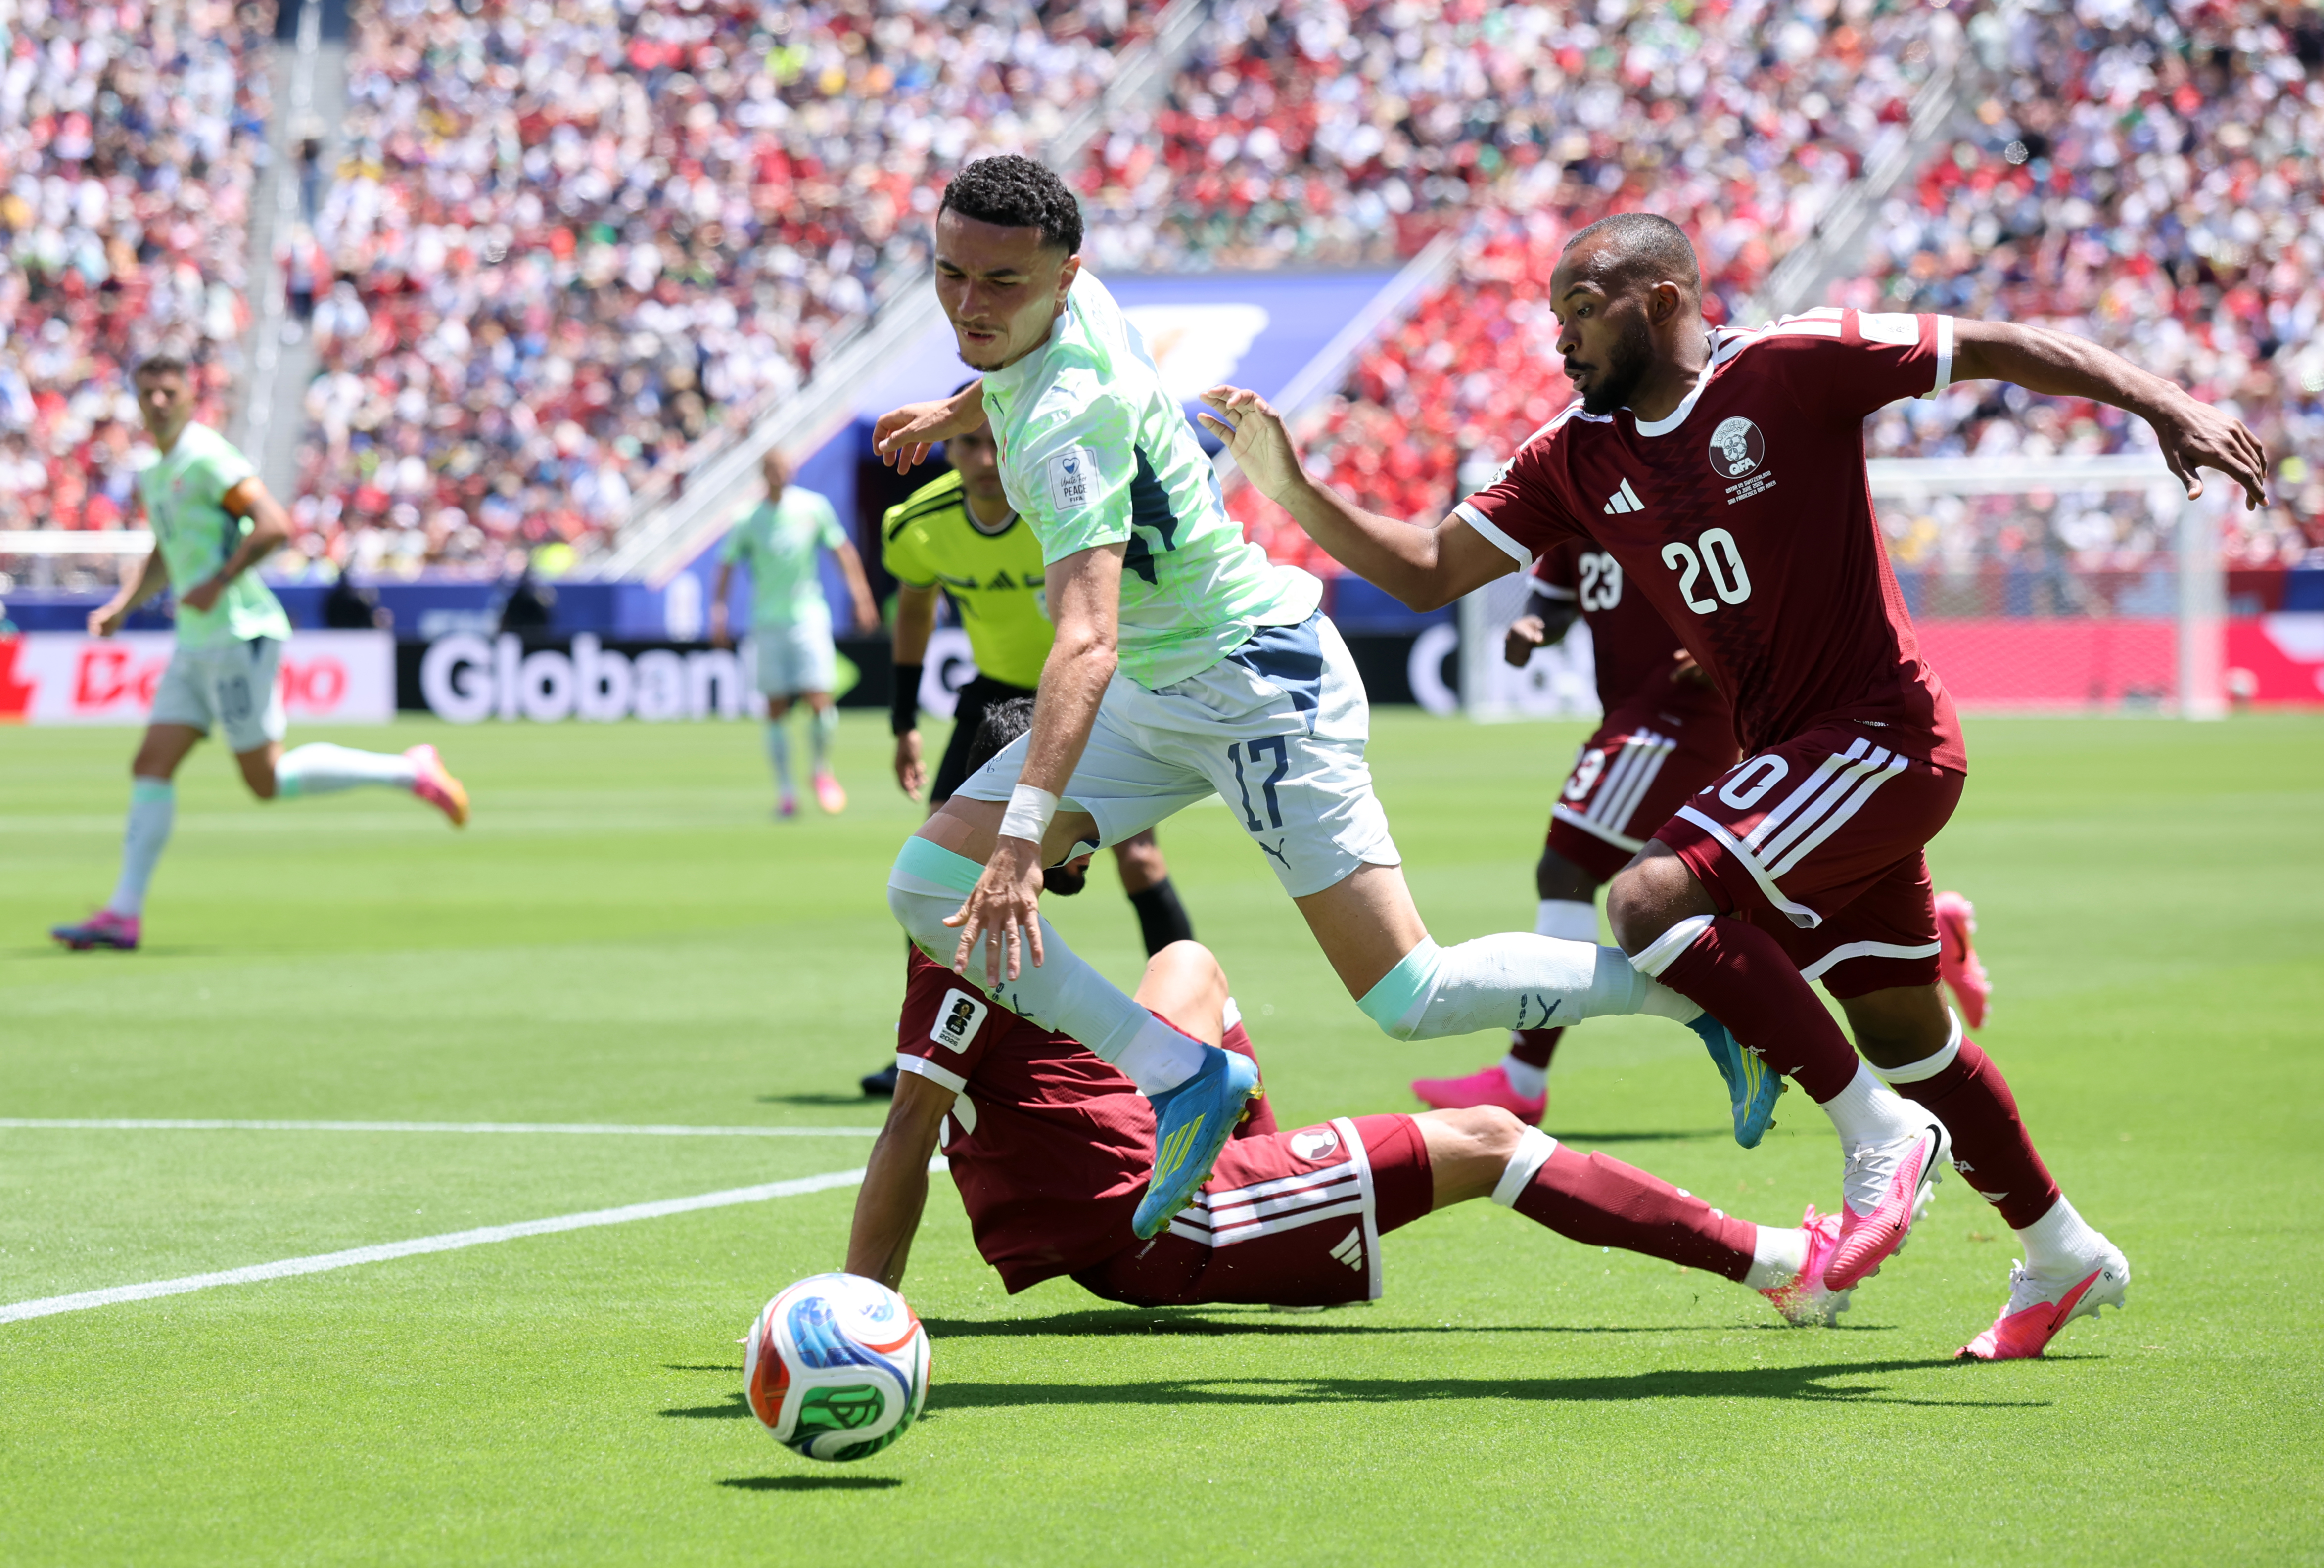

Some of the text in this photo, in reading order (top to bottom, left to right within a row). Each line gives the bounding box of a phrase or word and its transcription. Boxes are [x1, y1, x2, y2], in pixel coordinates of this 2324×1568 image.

[1729, 457, 1756, 475] QFA
[1061, 473, 1087, 487] Unite For
[1064, 484, 1088, 497] PEACE
[1725, 485, 1738, 494] QATAR
[1744, 470, 1772, 486] SWITZERLAND
[1736, 489, 1758, 502] FRANCISCO
[1766, 480, 1777, 490] AREA
[1742, 484, 1753, 493] JUNE
[1753, 480, 1764, 489] 2026
[1578, 551, 1623, 612] 23
[1661, 528, 1751, 614] 20
[1227, 736, 1289, 832] 17
[1565, 745, 1606, 801] 3
[939, 1033, 958, 1047] 2026
